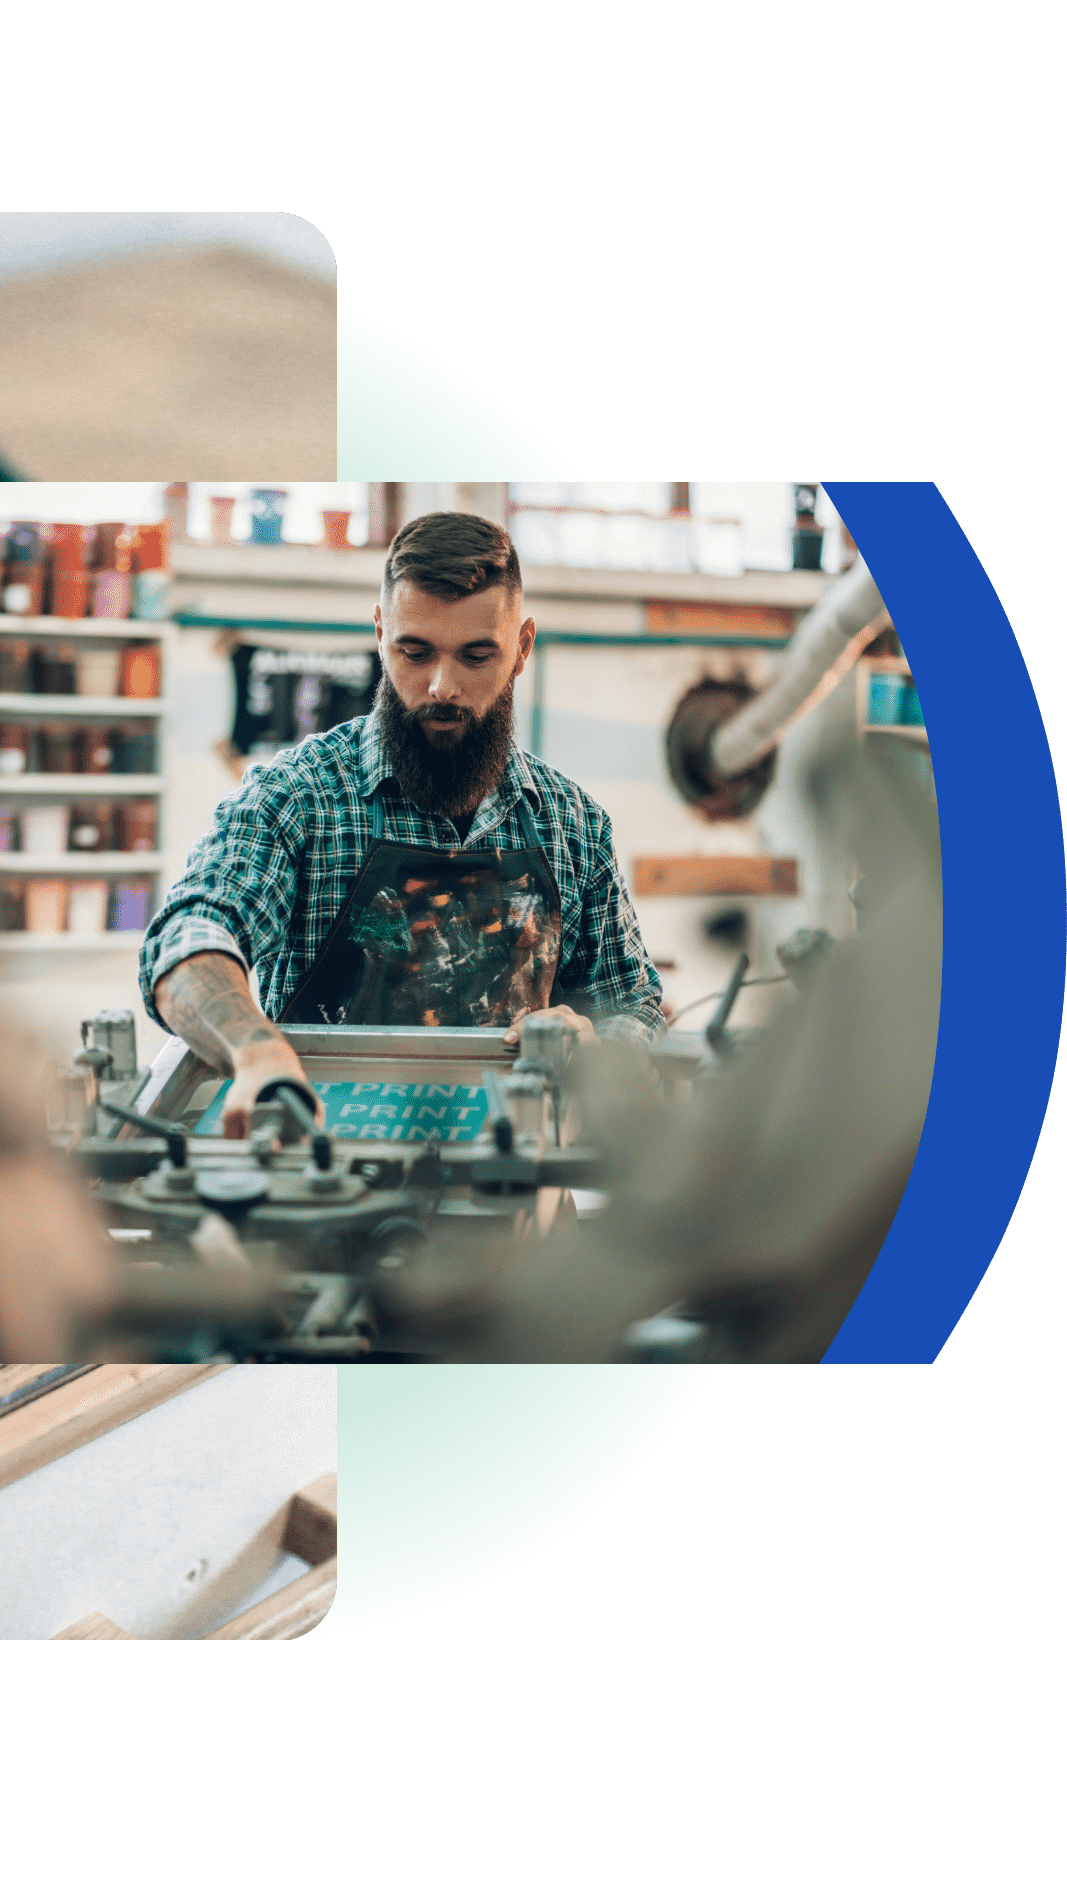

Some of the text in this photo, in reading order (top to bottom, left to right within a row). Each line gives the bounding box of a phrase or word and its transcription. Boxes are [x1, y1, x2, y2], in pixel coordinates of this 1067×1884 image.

[351, 1082, 488, 1099] PRINT
[338, 1103, 481, 1120] PRINT
[330, 1124, 472, 1141] PRINT
